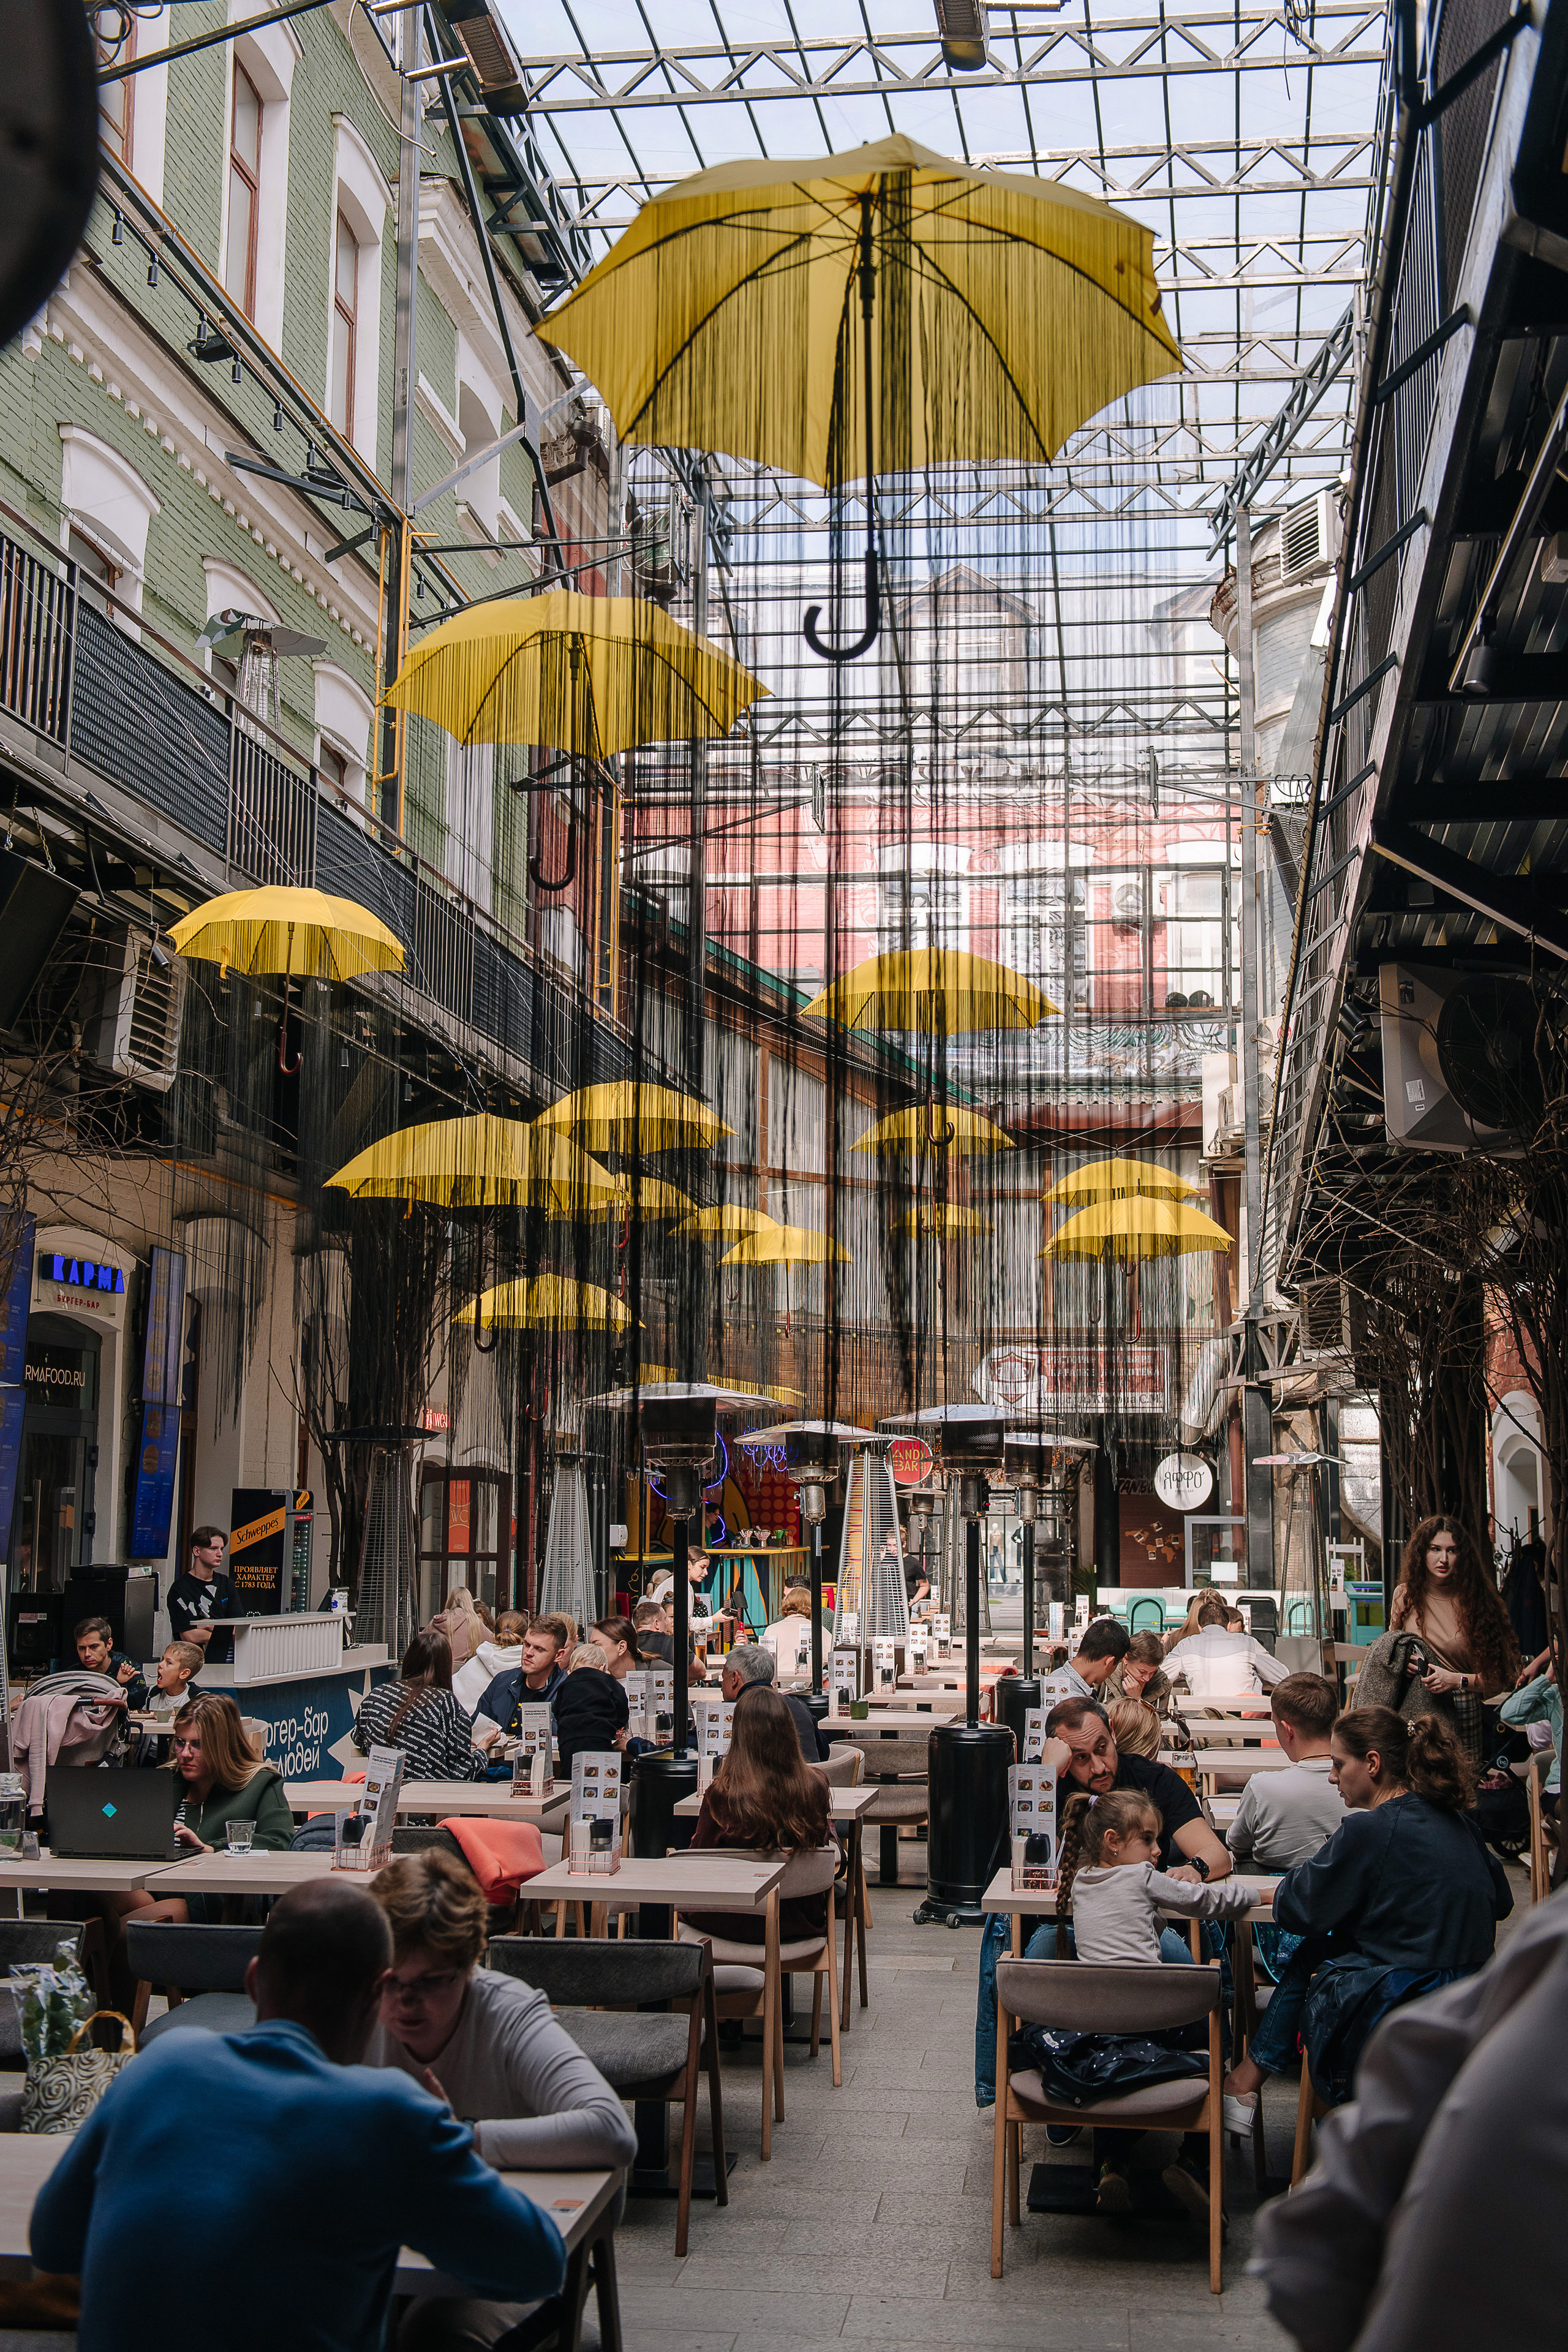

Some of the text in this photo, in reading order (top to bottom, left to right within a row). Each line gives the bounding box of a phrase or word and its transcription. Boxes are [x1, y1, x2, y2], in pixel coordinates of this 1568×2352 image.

[1291, 568, 1308, 579] VOLCANO
[53, 1254, 125, 1294] КАРМА
[57, 1294, 100, 1309] БУРГЕР-БАР
[25, 1365, 85, 1387] RMAFOOD.RU
[1164, 1471, 1205, 1489] ЯФФО
[451, 1509, 469, 1523] WC
[236, 1518, 279, 1544] Schweppes
